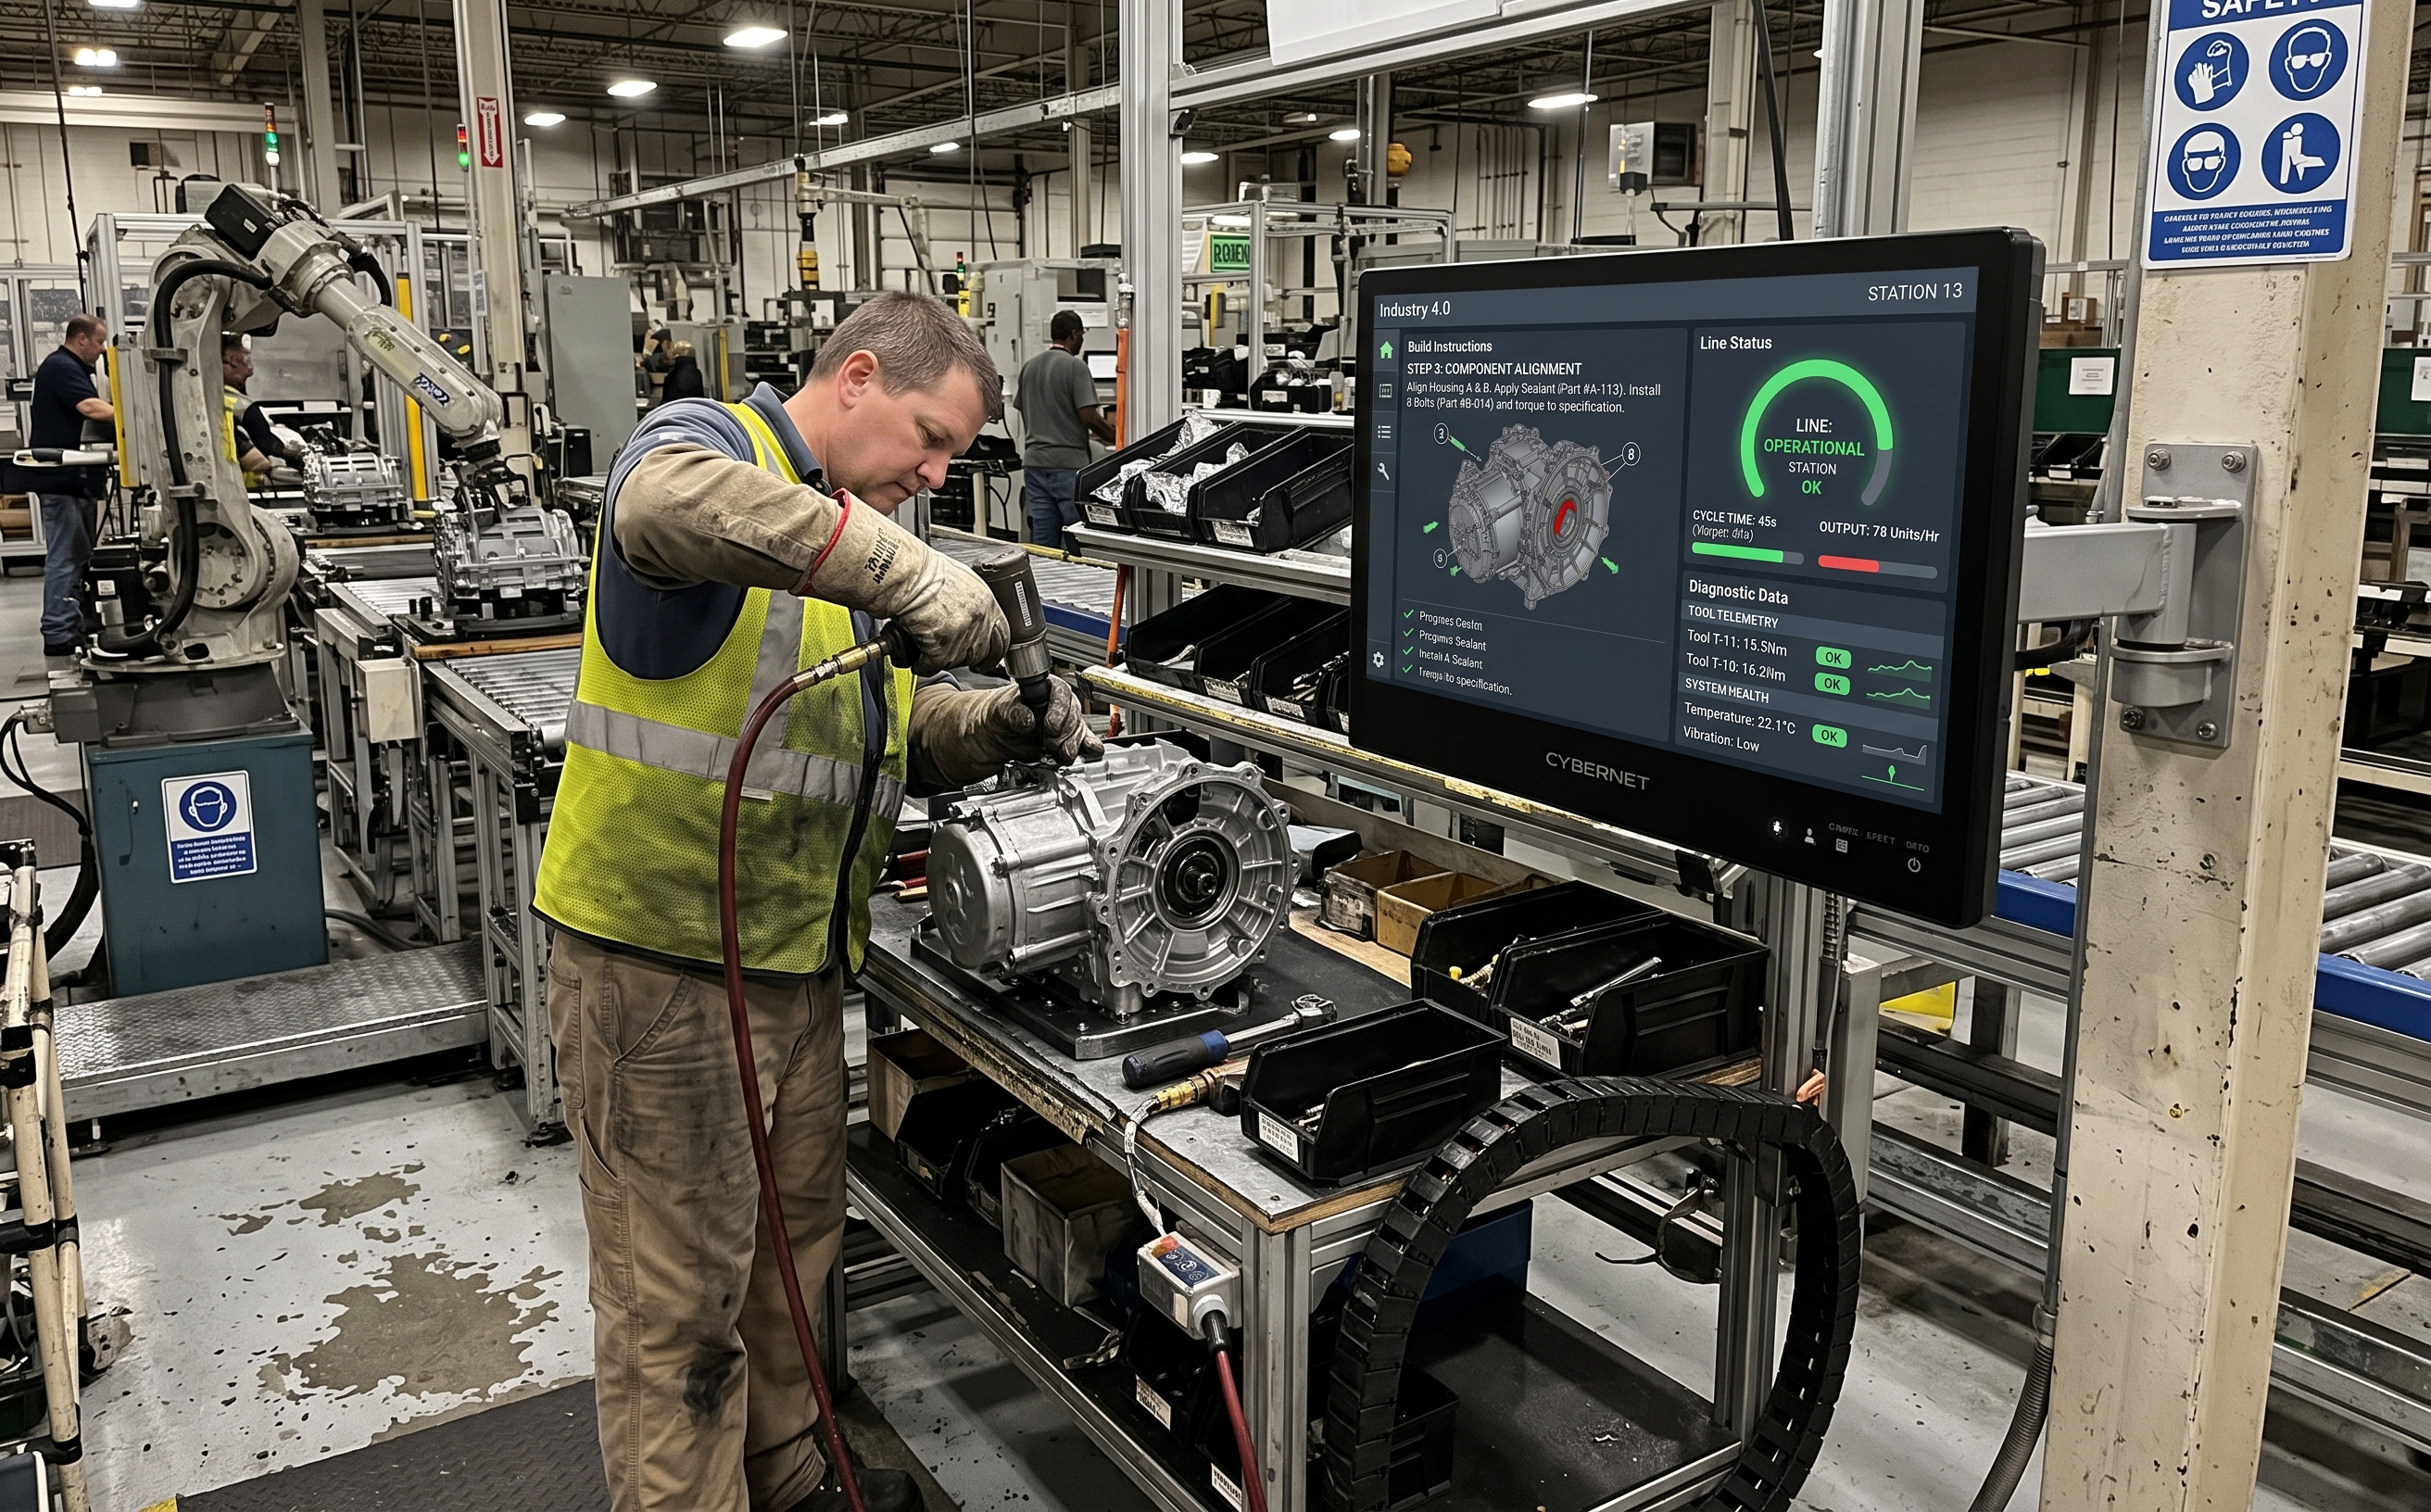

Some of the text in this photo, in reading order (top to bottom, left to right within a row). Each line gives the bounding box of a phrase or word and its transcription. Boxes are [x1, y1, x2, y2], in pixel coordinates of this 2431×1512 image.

[2201, 0, 2319, 19] SAF
[1868, 282, 1963, 302] STATION 13
[1380, 300, 1451, 319] Industry 4.0
[1408, 340, 1493, 353] Build Instructions
[1700, 335, 1772, 350] Line Status
[1407, 362, 1582, 376] STEP 3: COMPONENT ALIGNMENT
[1407, 382, 1427, 394] Align
[1430, 382, 1464, 395] Housing
[1466, 383, 1473, 393] A
[1475, 383, 1481, 393] &
[1483, 383, 1492, 393] B.
[1494, 383, 1520, 396] Apply
[1522, 383, 1556, 394] Sealant
[1629, 384, 1661, 396] Install
[1414, 397, 1435, 408] Bolts
[1437, 397, 1458, 410] (Part
[1496, 398, 1513, 410] and
[1515, 399, 1545, 414] torque
[1547, 401, 1556, 411] to
[1559, 400, 1625, 414] specification.
[1795, 417, 1833, 434] LINE:
[1627, 447, 1635, 461] 8
[1763, 438, 1865, 456] OPERATIONAL
[1788, 461, 1837, 476] STATION
[1801, 479, 1822, 495] OK
[1693, 509, 1777, 528] CYCLE TIME: 45s
[1819, 521, 1940, 543] OUTPUT: 78 Units/Hr
[1689, 579, 1789, 605] Diagnostic Data
[1688, 605, 1779, 630] TOOL TELEMETRY
[1455, 636, 1486, 651] Sealant
[1687, 629, 1710, 644] Tool
[1713, 633, 1740, 649] T-11:
[1825, 651, 1843, 665] OK
[1444, 653, 1450, 663] A
[1686, 652, 1709, 668] Tool
[1712, 656, 1739, 673] T-10:
[1824, 678, 1841, 691] OK
[1685, 678, 1727, 696] SYSTEM
[1684, 702, 1839, 743] Temperature: 22.1°C OK
[1683, 725, 1760, 753] Vibration: Low
[1545, 751, 1650, 791] CYBERNET
